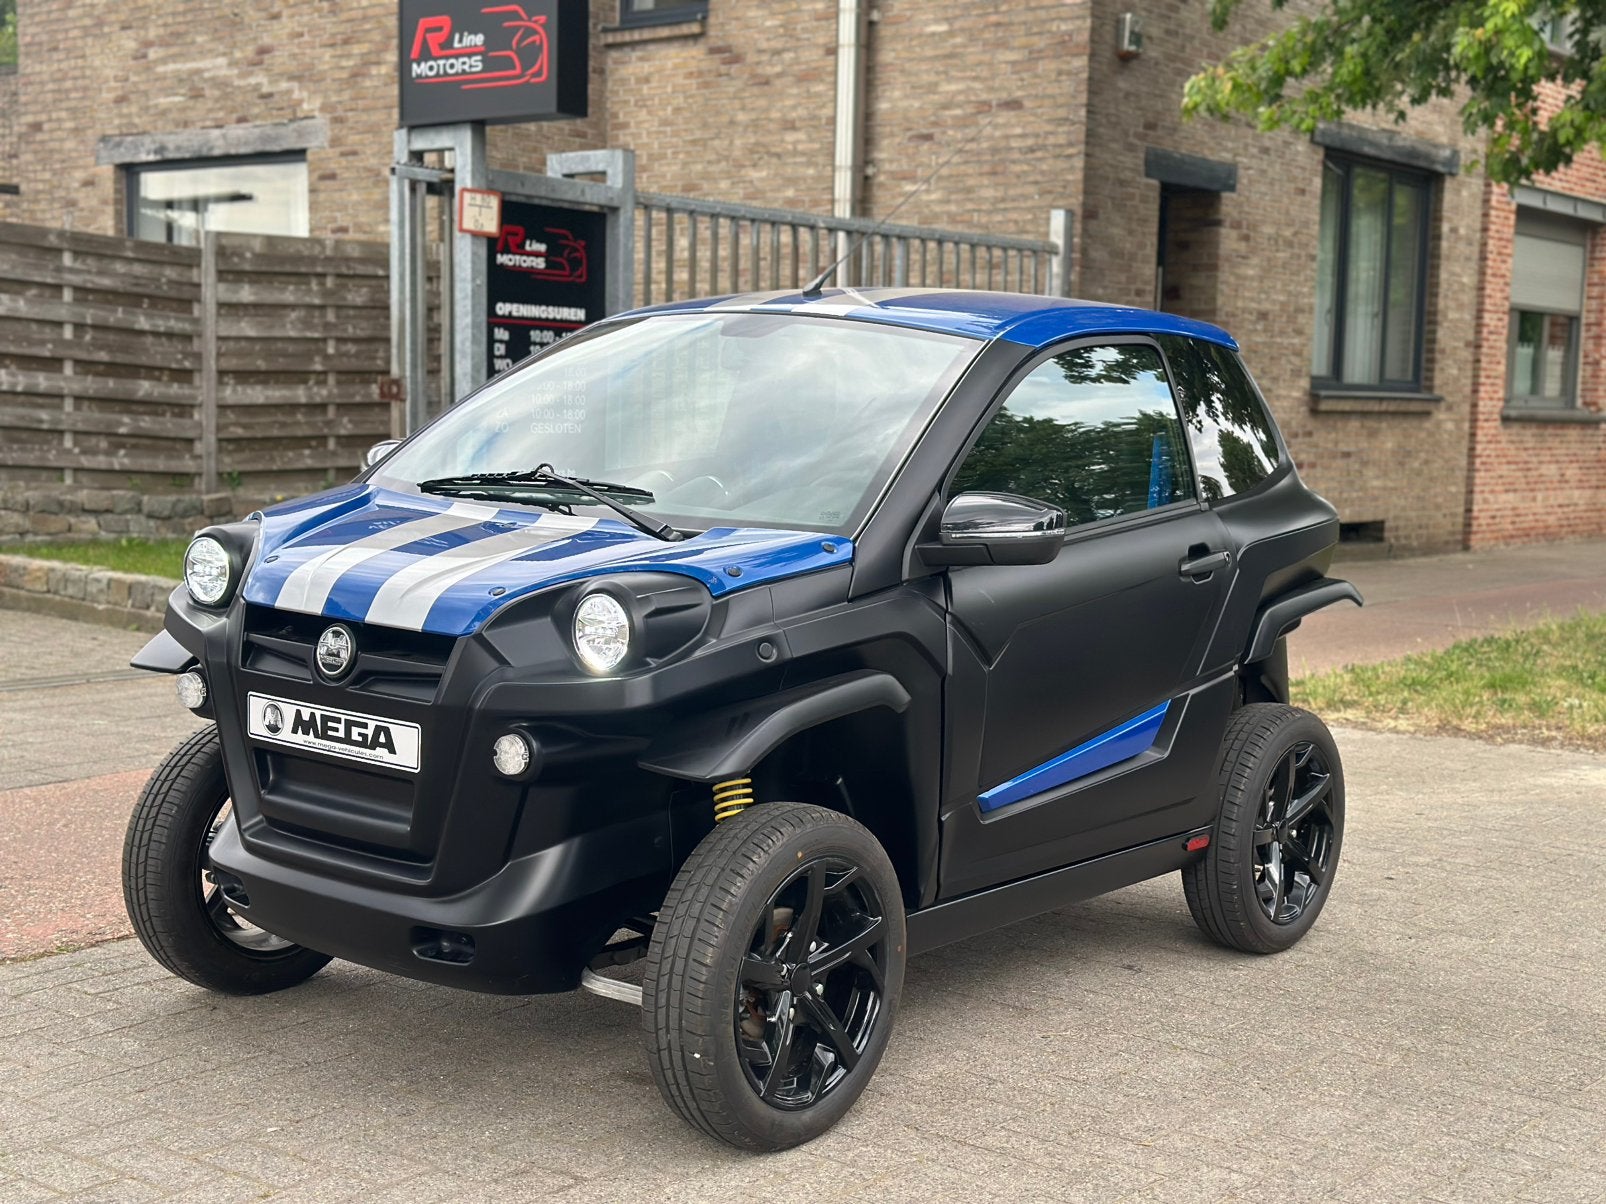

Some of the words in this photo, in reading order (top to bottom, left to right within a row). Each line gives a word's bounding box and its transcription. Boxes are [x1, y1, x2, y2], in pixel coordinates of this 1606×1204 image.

[411, 16, 451, 59] R
[453, 31, 485, 48] Line
[412, 56, 482, 78] MOTORS
[497, 225, 526, 253] R
[525, 240, 547, 253] Line
[496, 253, 546, 269] MOTORS
[495, 302, 586, 320] OPENINGSUREN
[529, 330, 554, 343] 10:00
[563, 408, 585, 419] 18:00
[530, 422, 582, 433] GESLOTEN
[291, 709, 397, 755] MEGA
